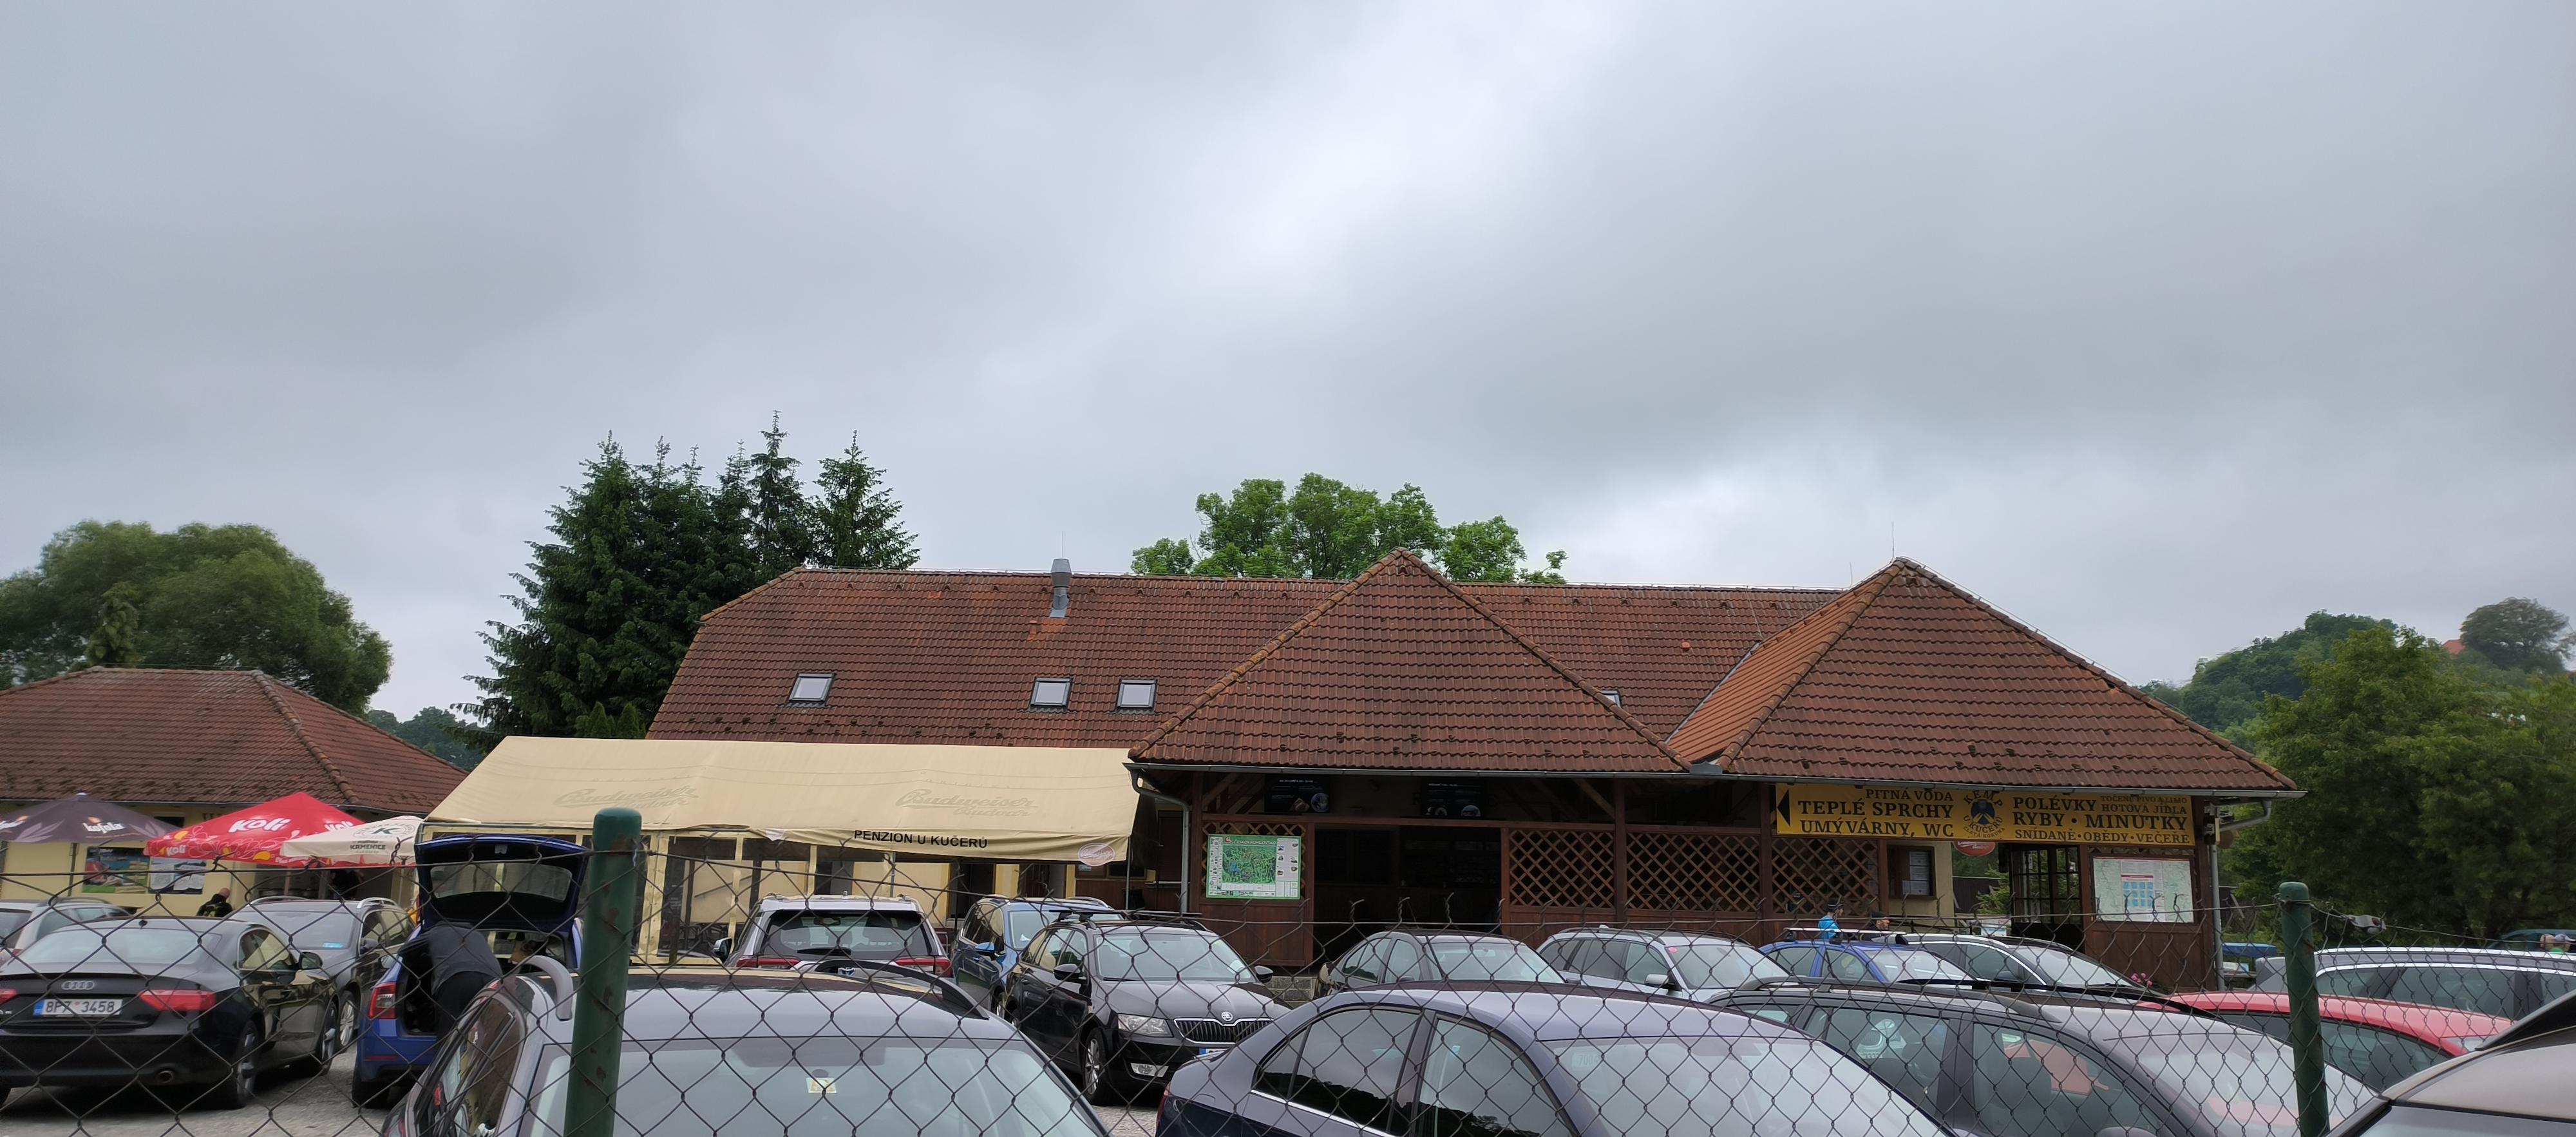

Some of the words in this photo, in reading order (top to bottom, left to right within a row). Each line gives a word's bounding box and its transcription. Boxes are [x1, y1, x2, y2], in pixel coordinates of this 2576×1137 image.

[895, 788, 1037, 807] Budweiser
[1866, 788, 1911, 800] PITNÁ
[1914, 790, 1954, 801] VODA
[1963, 790, 2003, 806] KEMP
[2012, 794, 2097, 811] POLÉVKY
[1798, 798, 1865, 816] TEPLÉ
[1872, 801, 1954, 818] SPRCHY
[2101, 803, 2149, 814] HOTOVÁ
[82, 822, 126, 834] kofola
[228, 817, 291, 834] Koli
[1800, 817, 1915, 837] UMÝVÁRNY,
[1922, 823, 1954, 837] WC
[2012, 811, 2065, 827] RYBY
[2085, 814, 2188, 830] MINUTKY
[854, 830, 913, 843] PENZION
[917, 835, 926, 845] U
[931, 835, 987, 848] KUČERŮ
[166, 845, 186, 856] Koli
[46, 1001, 71, 1013] 8P7
[81, 1001, 115, 1013] 3458
